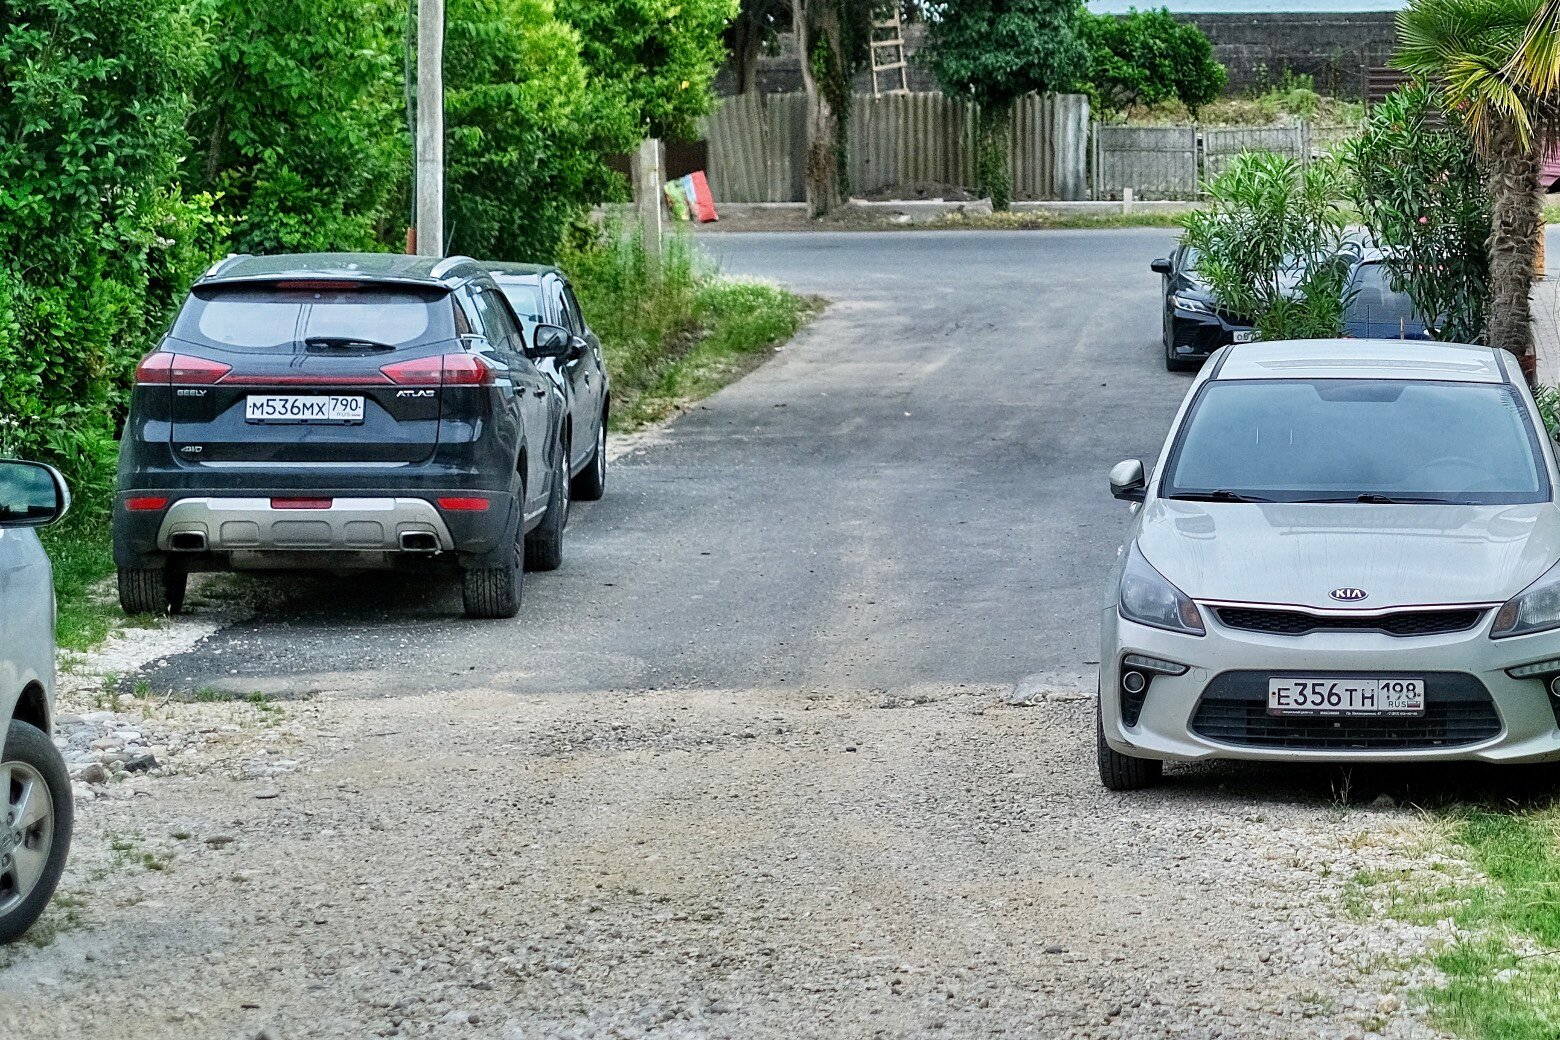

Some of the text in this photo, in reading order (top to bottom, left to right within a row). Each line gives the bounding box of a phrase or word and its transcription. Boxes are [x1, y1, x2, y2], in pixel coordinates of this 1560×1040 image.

[177, 389, 207, 397] GEELY
[396, 390, 435, 398] ATLAS
[331, 398, 359, 412] 790
[1336, 589, 1362, 598] KIA
[1380, 682, 1416, 700] 198
[1388, 700, 1407, 708] RUS
